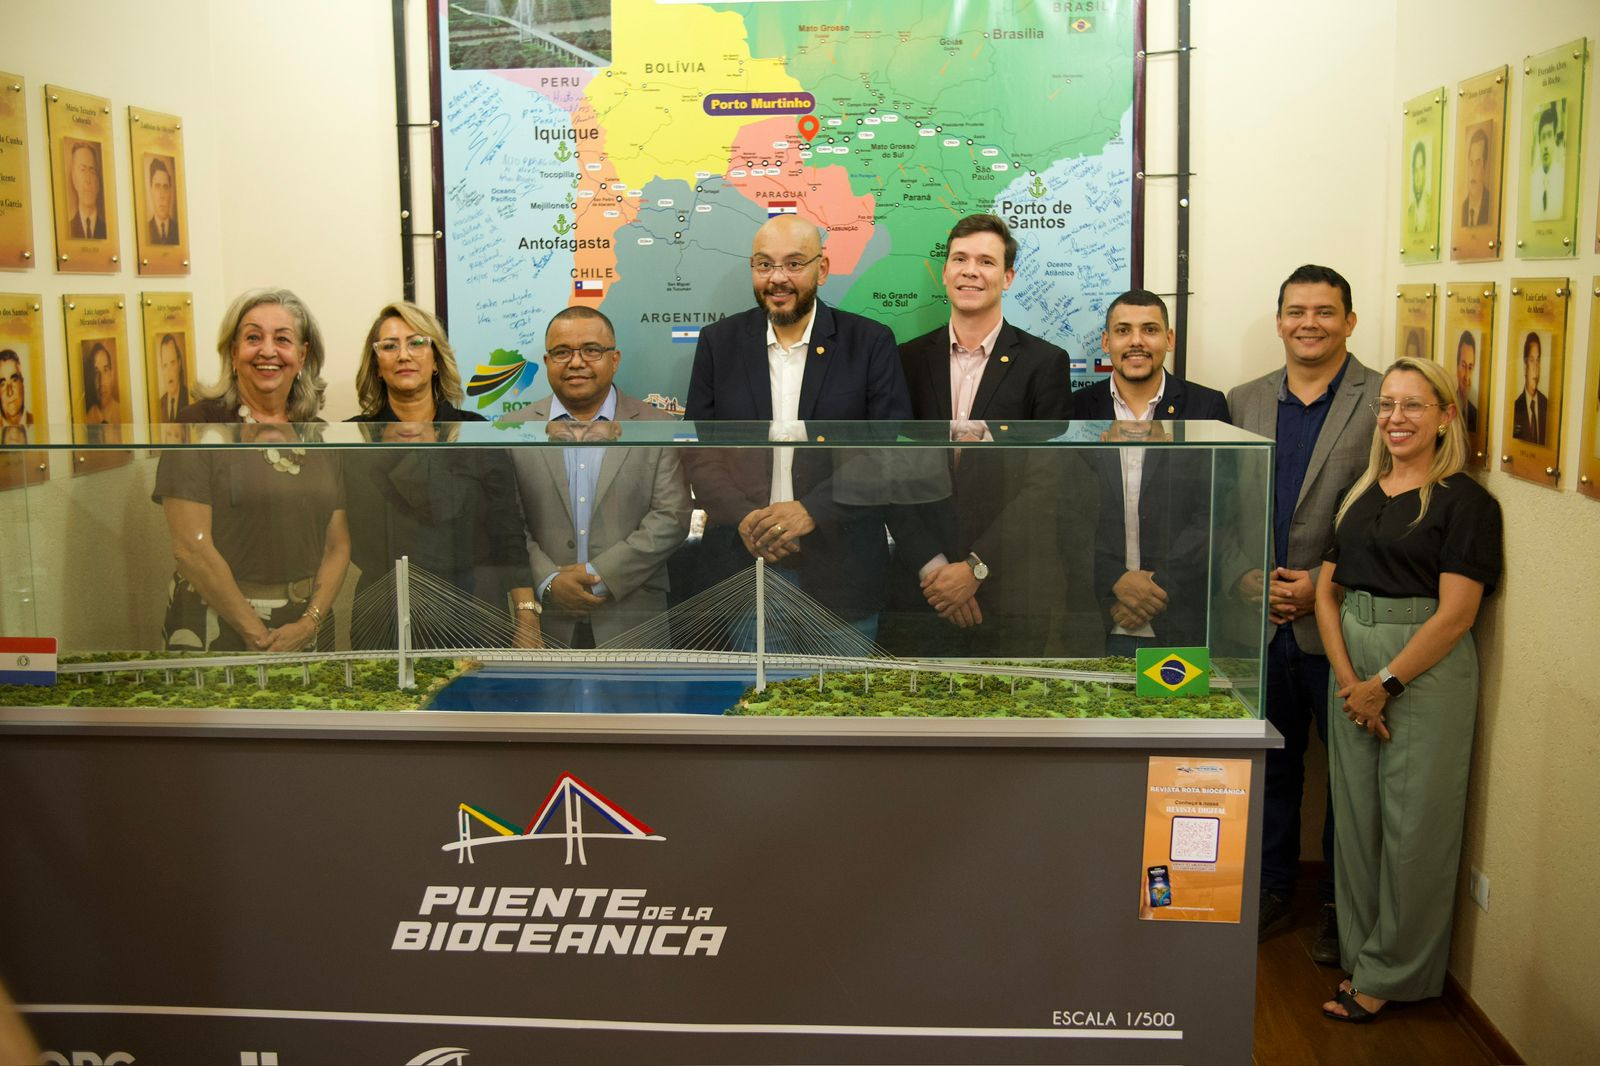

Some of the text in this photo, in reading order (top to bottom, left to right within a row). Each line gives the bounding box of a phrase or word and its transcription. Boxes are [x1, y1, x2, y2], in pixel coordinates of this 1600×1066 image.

[1053, 2, 1108, 12] BRASIL
[940, 38, 963, 46] Goiás
[645, 61, 705, 74] BOLÍVIA
[541, 77, 580, 87] PERU
[711, 98, 812, 109] Porto Murtinho
[535, 125, 599, 144] Iquique
[540, 171, 575, 180] Tocopilla
[530, 202, 569, 211] Mejillones
[1002, 200, 1072, 215] Porto de
[1008, 215, 1066, 229] Santos
[518, 236, 610, 253] Antofagasta
[570, 268, 613, 279] CHILE
[641, 312, 727, 323] ARGENTINA
[1198, 807, 1226, 815] DIGITAL
[418, 886, 714, 921] PUENTE DE LA
[391, 921, 727, 956] BIOCEANICA
[1053, 1011, 1175, 1027] ESCALA 1/500
